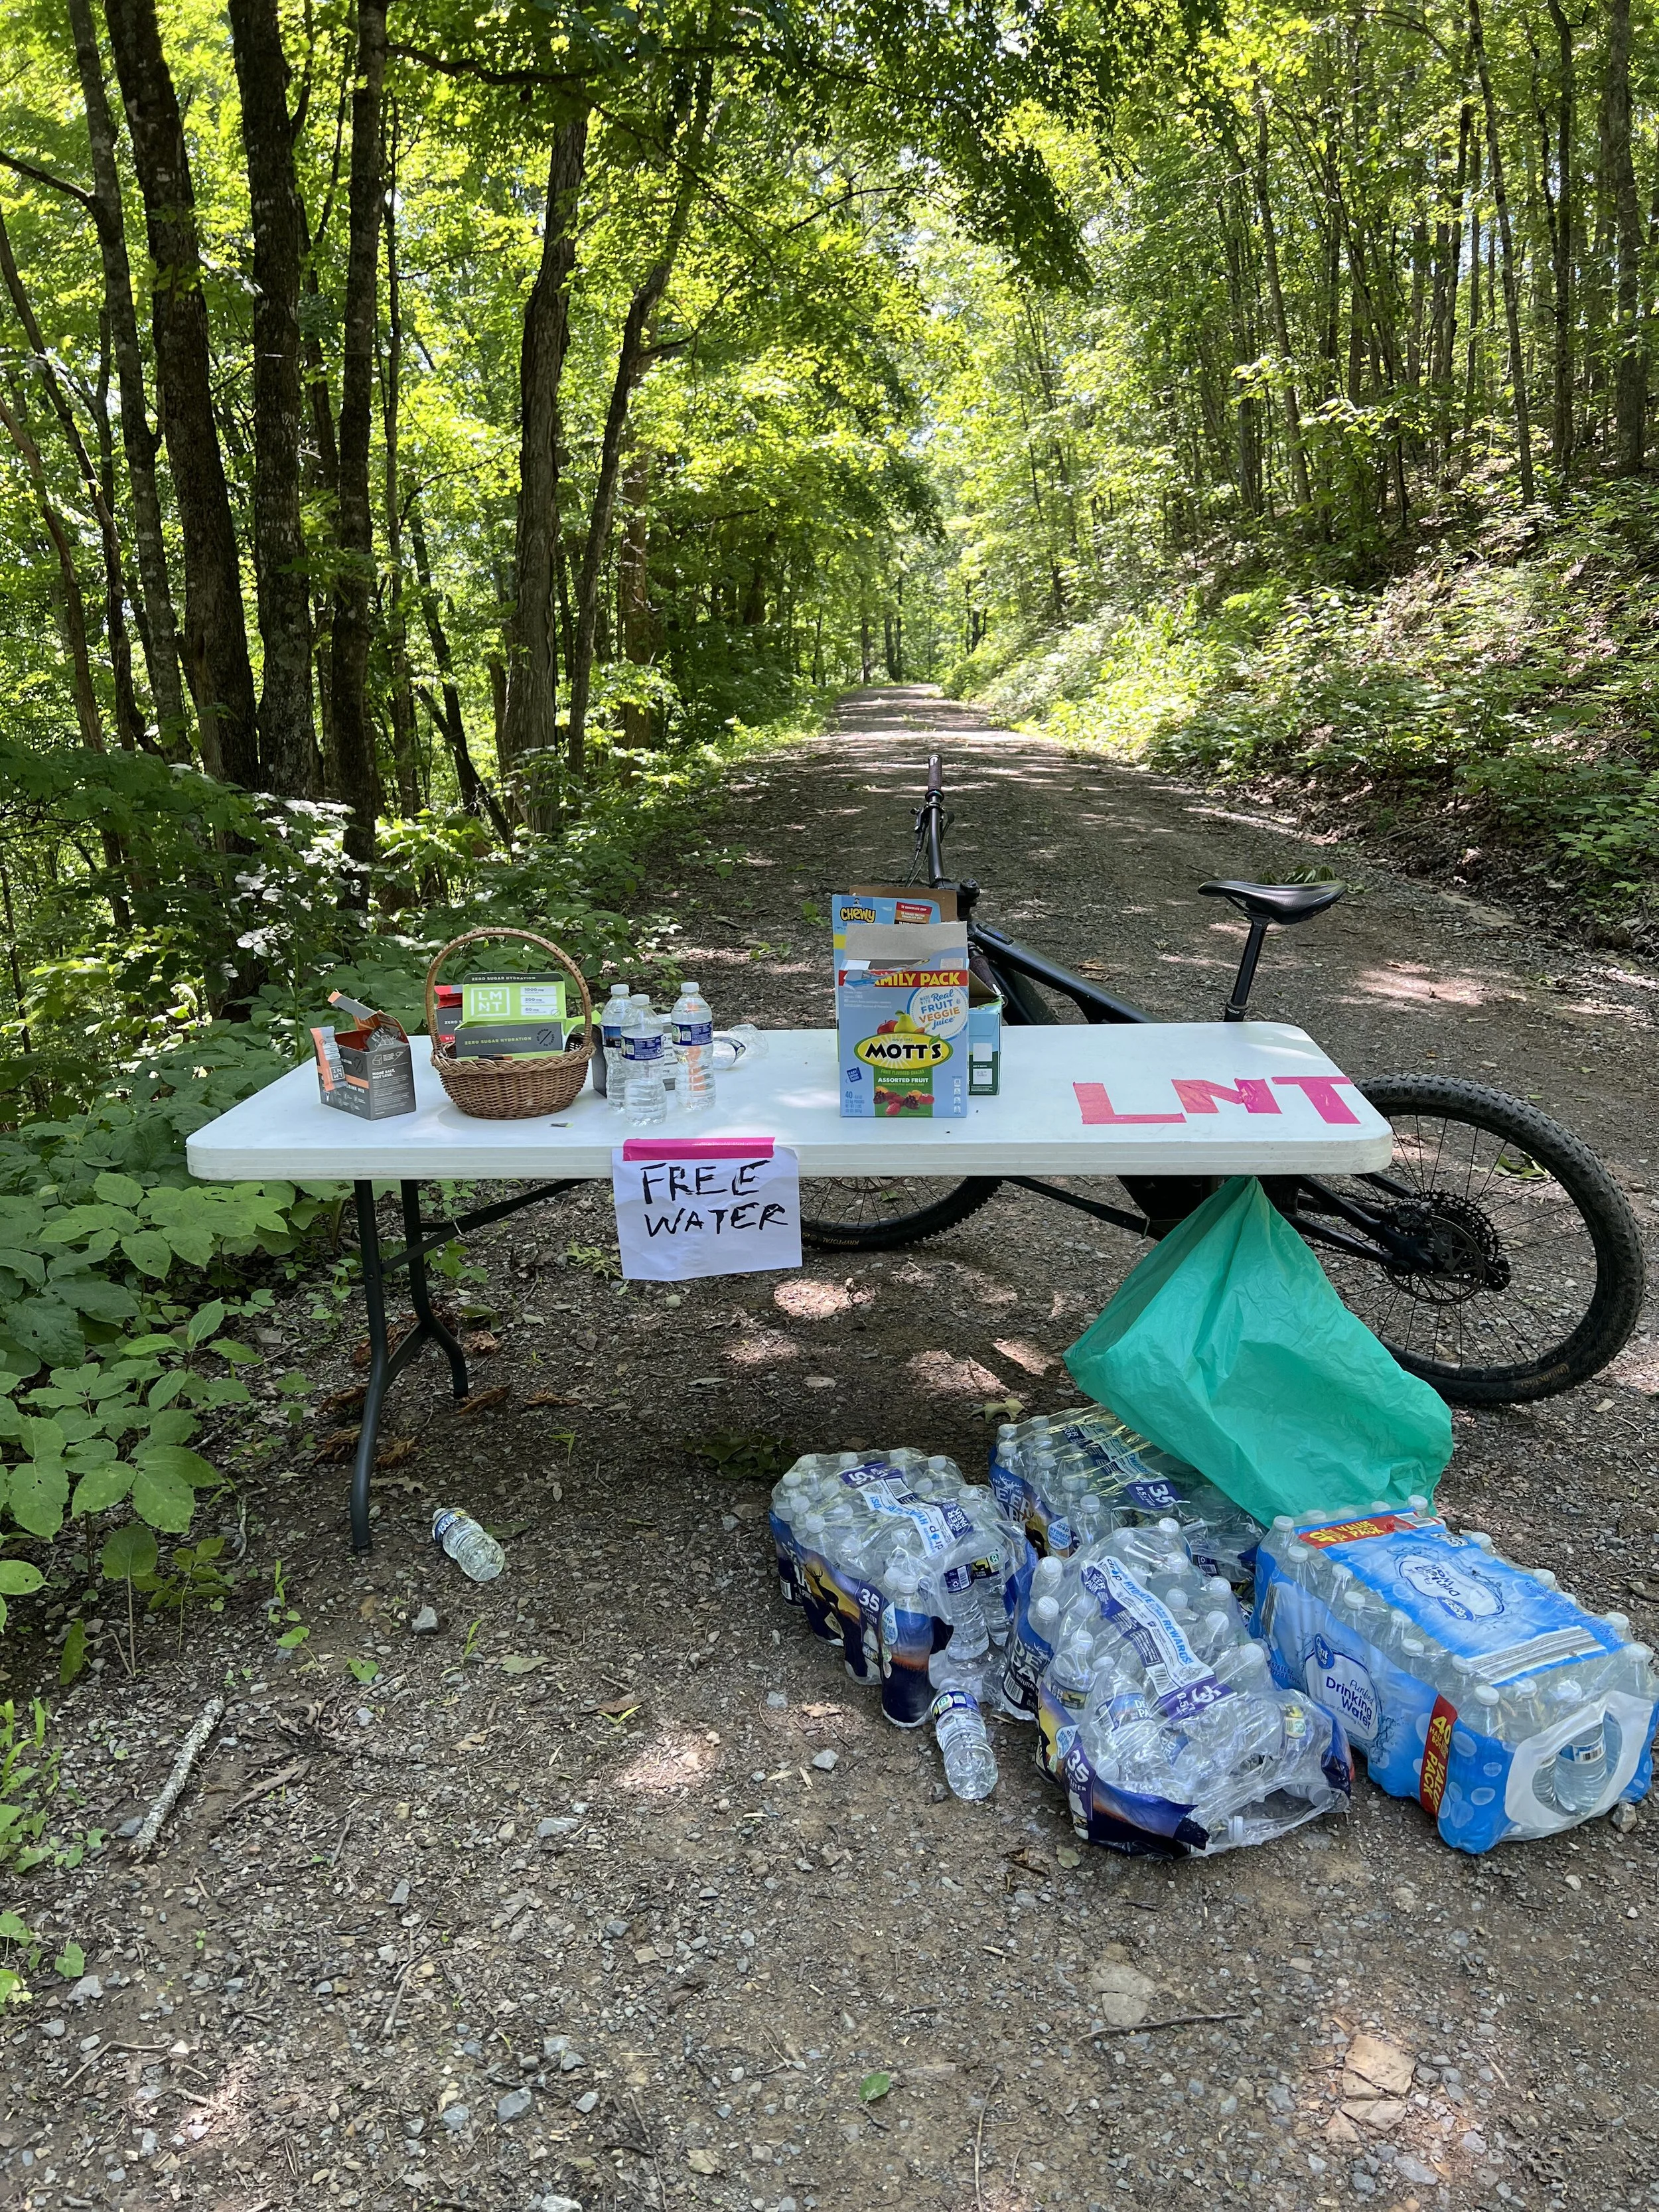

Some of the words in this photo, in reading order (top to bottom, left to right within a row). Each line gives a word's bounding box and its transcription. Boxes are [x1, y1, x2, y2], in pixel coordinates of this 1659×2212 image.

[874, 972, 916, 986] AMILY
[920, 972, 960, 986] PACK
[478, 991, 502, 1001] LM
[931, 988, 955, 1002] Real
[478, 1001, 502, 1011] NT
[919, 1006, 961, 1023] VEGGIE
[920, 999, 953, 1014] FRUIT
[640, 1159, 772, 1205] FREE
[644, 1202, 789, 1238] WATER
[995, 1485, 1033, 1518] EER
[1148, 1484, 1177, 1504] 35
[947, 1511, 963, 1532] DEER
[954, 1507, 970, 1530] PARK
[1056, 1523, 1069, 1532] drop
[1336, 1520, 1375, 1532] VALUE
[1348, 1526, 1385, 1538] PACK
[1107, 1559, 1122, 1582] drop
[1084, 1580, 1101, 1593] PARK
[1091, 1574, 1106, 1589] DEER
[859, 1588, 880, 1612] 35
[1123, 1581, 1155, 1604] HYDRATE
[1162, 1619, 1194, 1665] REWARDS!
[1016, 1673, 1036, 1692] NATURAL
[1327, 1676, 1372, 1720] Drinking
[1350, 1679, 1374, 1707] Purified
[1134, 1700, 1147, 1709] DE
[1138, 1708, 1150, 1718] PA
[1341, 1695, 1371, 1730] Water
[1429, 1726, 1443, 1743] HALF
[1433, 1716, 1451, 1745] 40
[1067, 1749, 1090, 1783] 35
[1423, 1750, 1439, 1800] PACK
[1070, 1780, 1087, 1792] LITER
